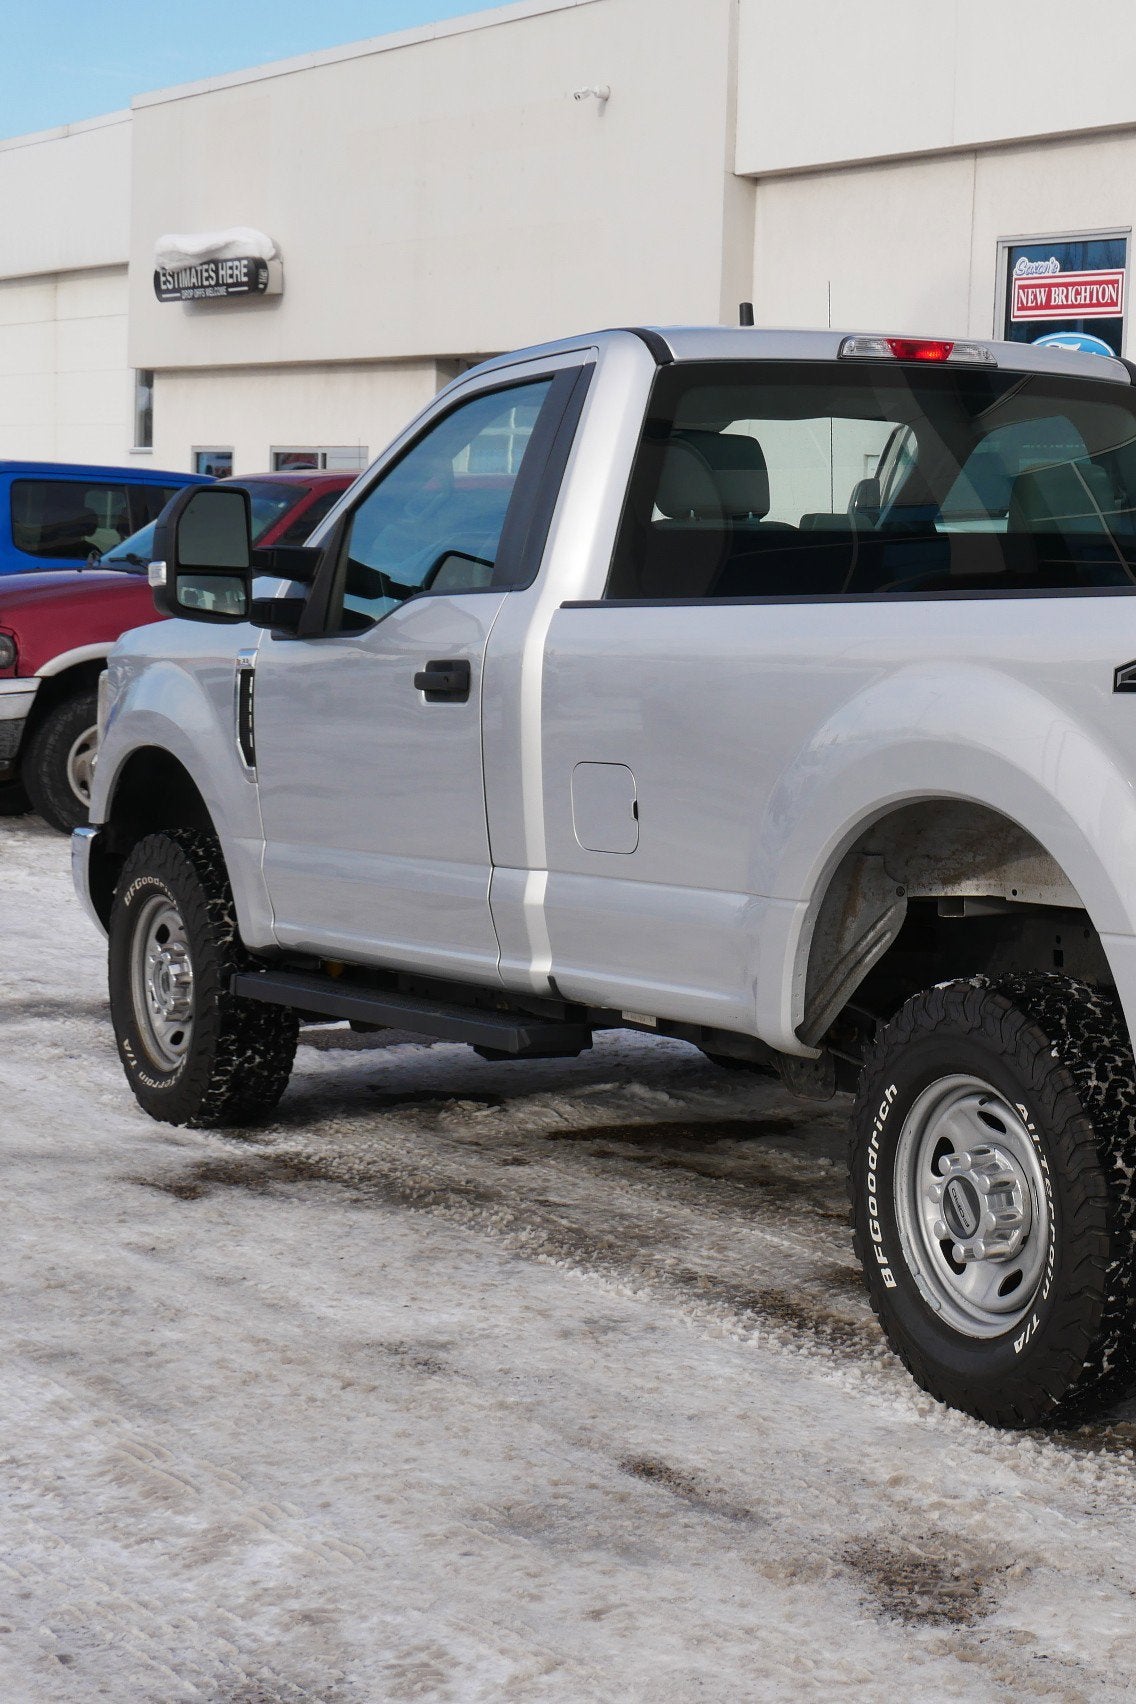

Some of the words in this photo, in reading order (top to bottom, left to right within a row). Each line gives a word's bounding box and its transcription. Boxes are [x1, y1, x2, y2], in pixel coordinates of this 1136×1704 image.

[160, 263, 216, 290] ESTIMATES
[219, 259, 249, 284] HERE
[1015, 258, 1059, 276] Saxon's
[1018, 288, 1049, 307] NEW
[1050, 283, 1118, 306] BRIGHTON
[124, 876, 179, 911] BFGoodri
[868, 1084, 898, 1288] BFGoodrich
[1016, 1103, 1056, 1300] All-Terrain
[1013, 1314, 1040, 1354] T/A
